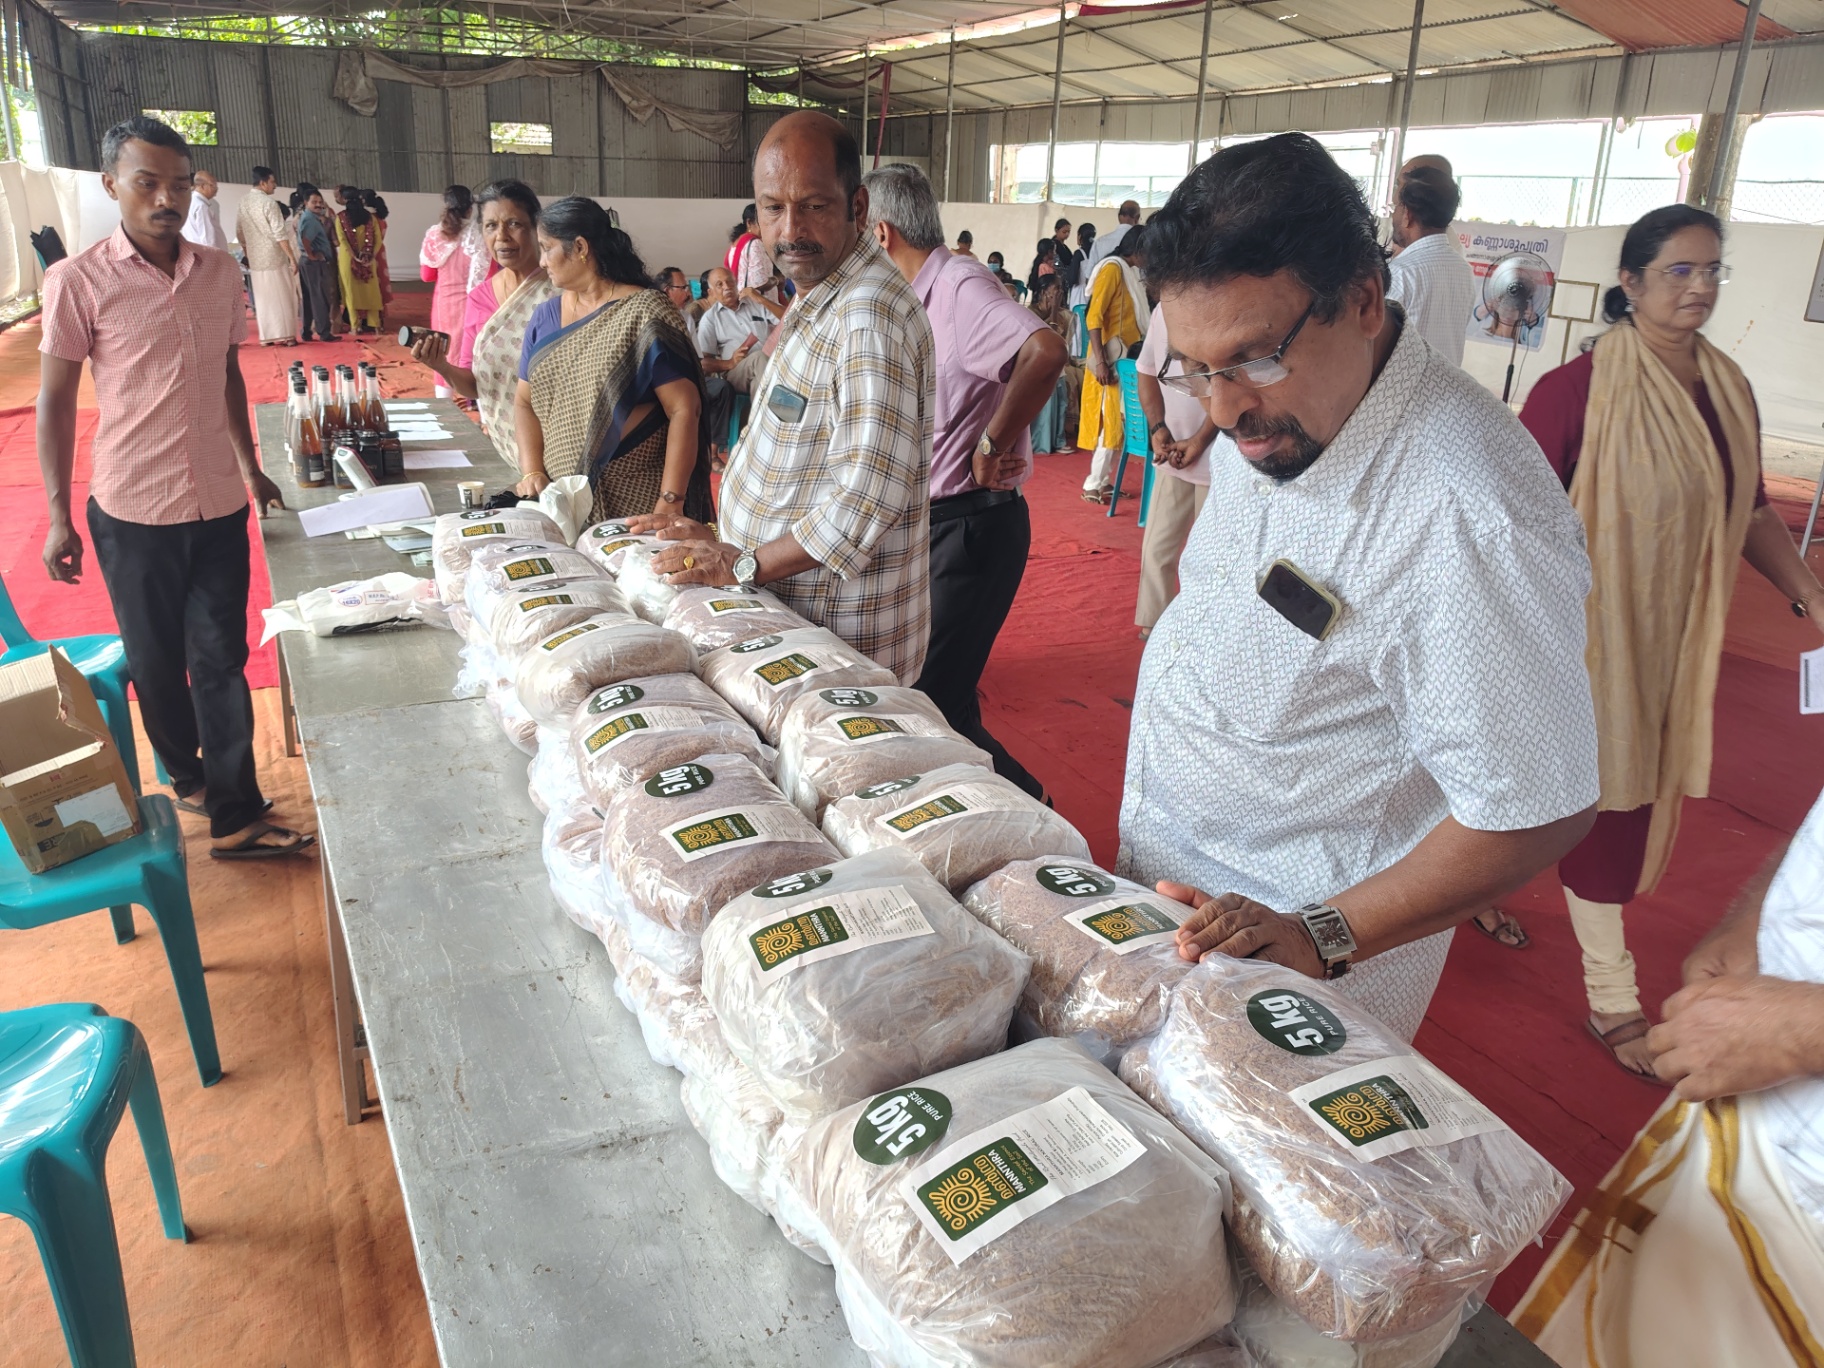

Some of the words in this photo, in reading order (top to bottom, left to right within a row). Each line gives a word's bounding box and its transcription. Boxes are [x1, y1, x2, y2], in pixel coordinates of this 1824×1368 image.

[662, 782, 692, 795] 5
[1045, 866, 1085, 885] kg
[771, 882, 805, 895] 5
[1065, 883, 1097, 895] 5
[1258, 994, 1308, 1028] kg
[1315, 1015, 1338, 1035] PURE
[1284, 1027, 1324, 1048] 5
[906, 1090, 926, 1106] RICE
[865, 1097, 913, 1145] kg
[921, 1103, 944, 1121] PURE
[885, 1123, 925, 1156] 5
[988, 1148, 1027, 1193] MANNTHRA
